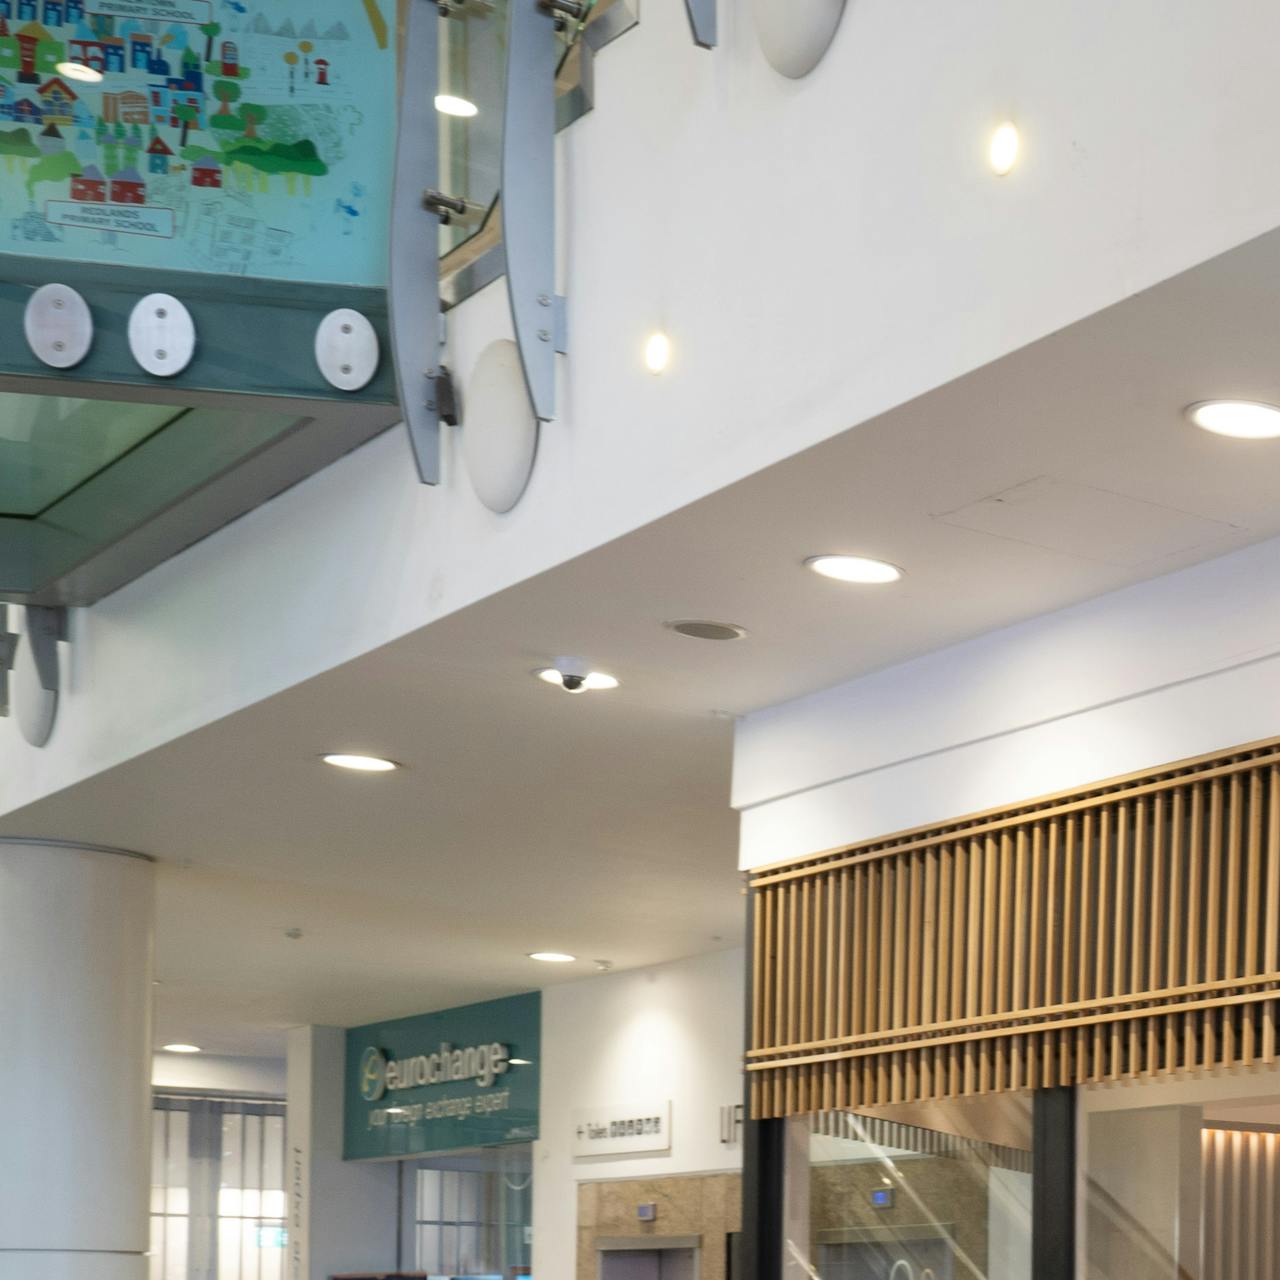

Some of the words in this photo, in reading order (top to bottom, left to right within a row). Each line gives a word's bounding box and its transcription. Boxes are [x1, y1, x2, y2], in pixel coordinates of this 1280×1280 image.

[151, 8, 195, 20] SCHOOL
[113, 218, 158, 232] SCHOOL
[385, 1042, 508, 1087] eurochange
[425, 1095, 472, 1120] exchange
[475, 1088, 510, 1116] expert
